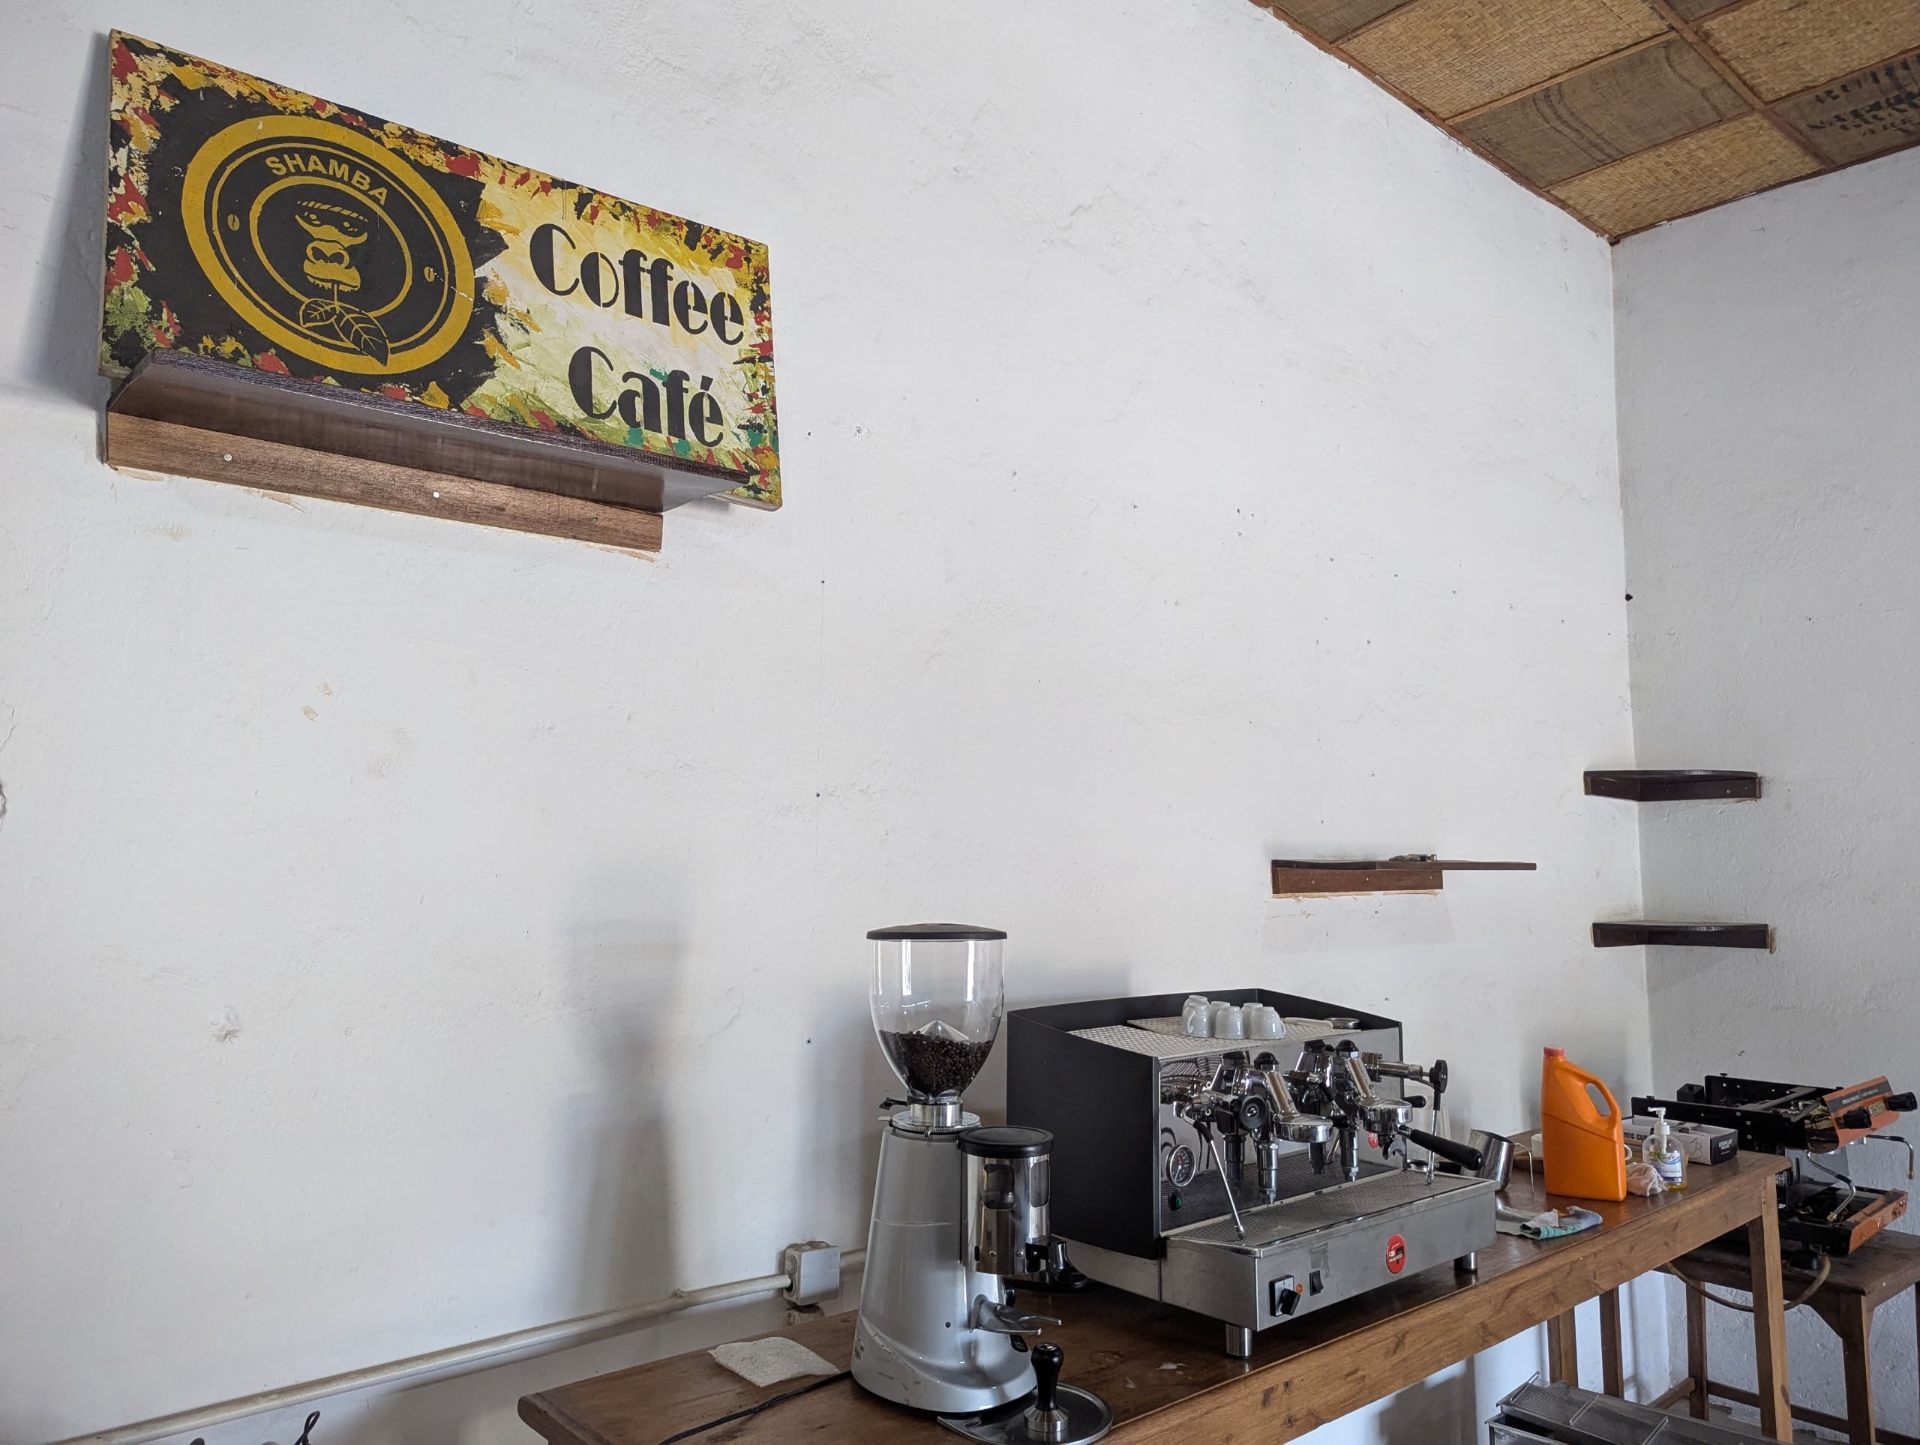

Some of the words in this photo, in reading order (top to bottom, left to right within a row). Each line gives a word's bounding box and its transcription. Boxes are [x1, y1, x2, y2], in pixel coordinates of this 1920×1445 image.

[265, 153, 389, 206] SHAMBA
[529, 223, 744, 345] Coffee
[568, 346, 724, 447] Café
